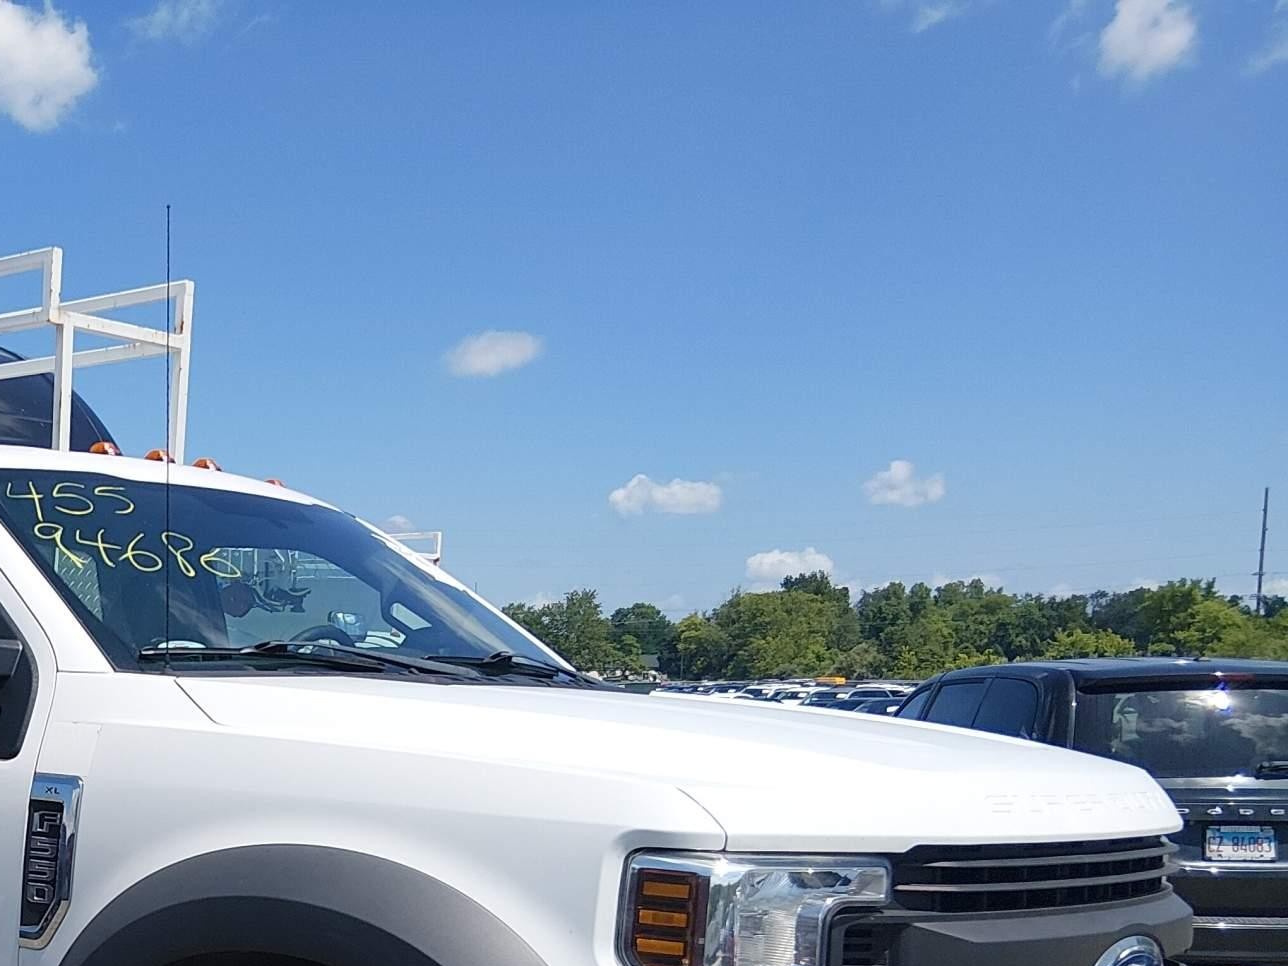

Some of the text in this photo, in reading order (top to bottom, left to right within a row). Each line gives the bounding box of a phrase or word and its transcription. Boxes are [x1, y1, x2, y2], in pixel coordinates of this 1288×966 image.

[7, 481, 135, 521] 455
[34, 522, 241, 577] 94686
[44, 786, 60, 795] XL
